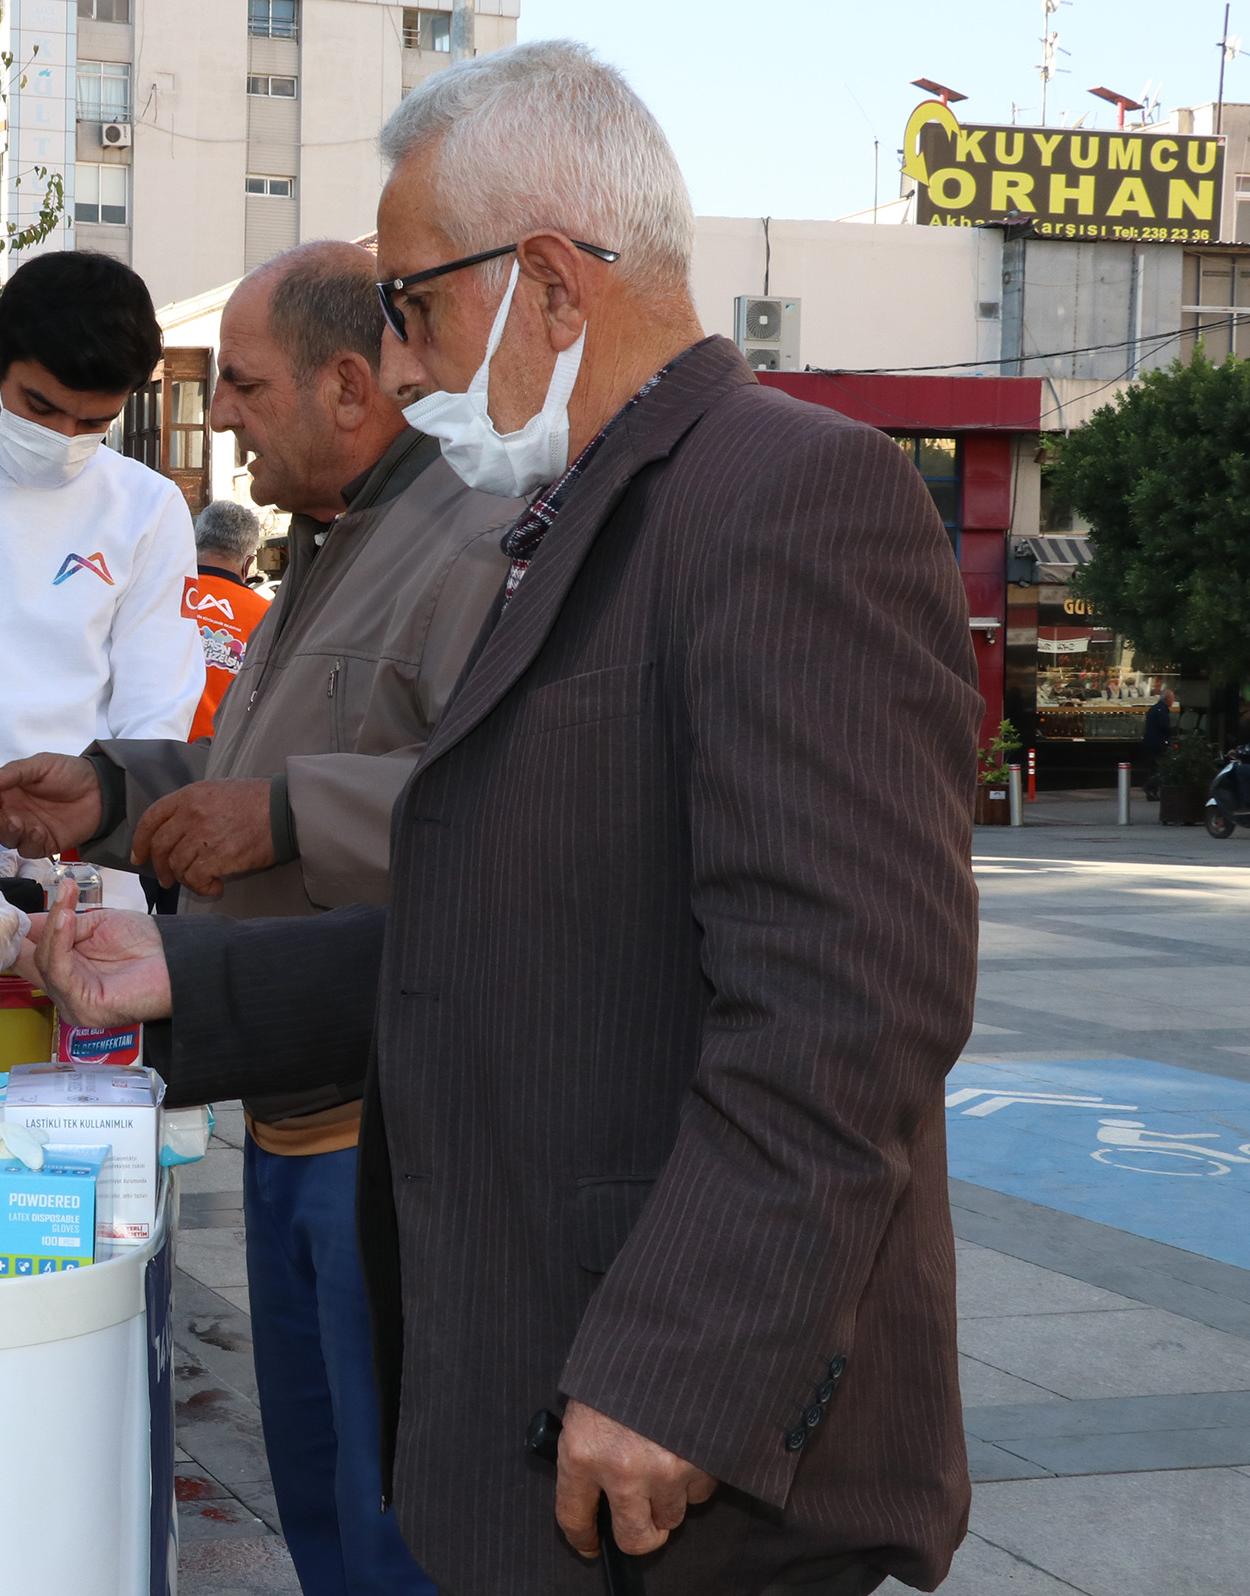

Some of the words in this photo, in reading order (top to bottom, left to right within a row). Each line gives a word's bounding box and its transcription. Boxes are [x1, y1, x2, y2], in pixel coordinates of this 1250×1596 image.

[955, 130, 1218, 174] KUYUMCU
[927, 167, 1215, 220] ORHAN
[1112, 226, 1138, 237] Tel:
[1141, 227, 1168, 238] 238
[1171, 228, 1189, 239] 23
[1192, 229, 1210, 240] 36
[201, 638, 232, 656] ERSİN
[25, 1118, 61, 1128] LASTİKLİ
[63, 1119, 78, 1128] TEK
[80, 1119, 134, 1129] KULLANIMLIK
[9, 1193, 81, 1209] POWDERED
[9, 1213, 30, 1222] LATEX
[31, 1213, 80, 1224] DISPOSABLE
[52, 1224, 80, 1233] GLOVES
[42, 1236, 58, 1247] 100
